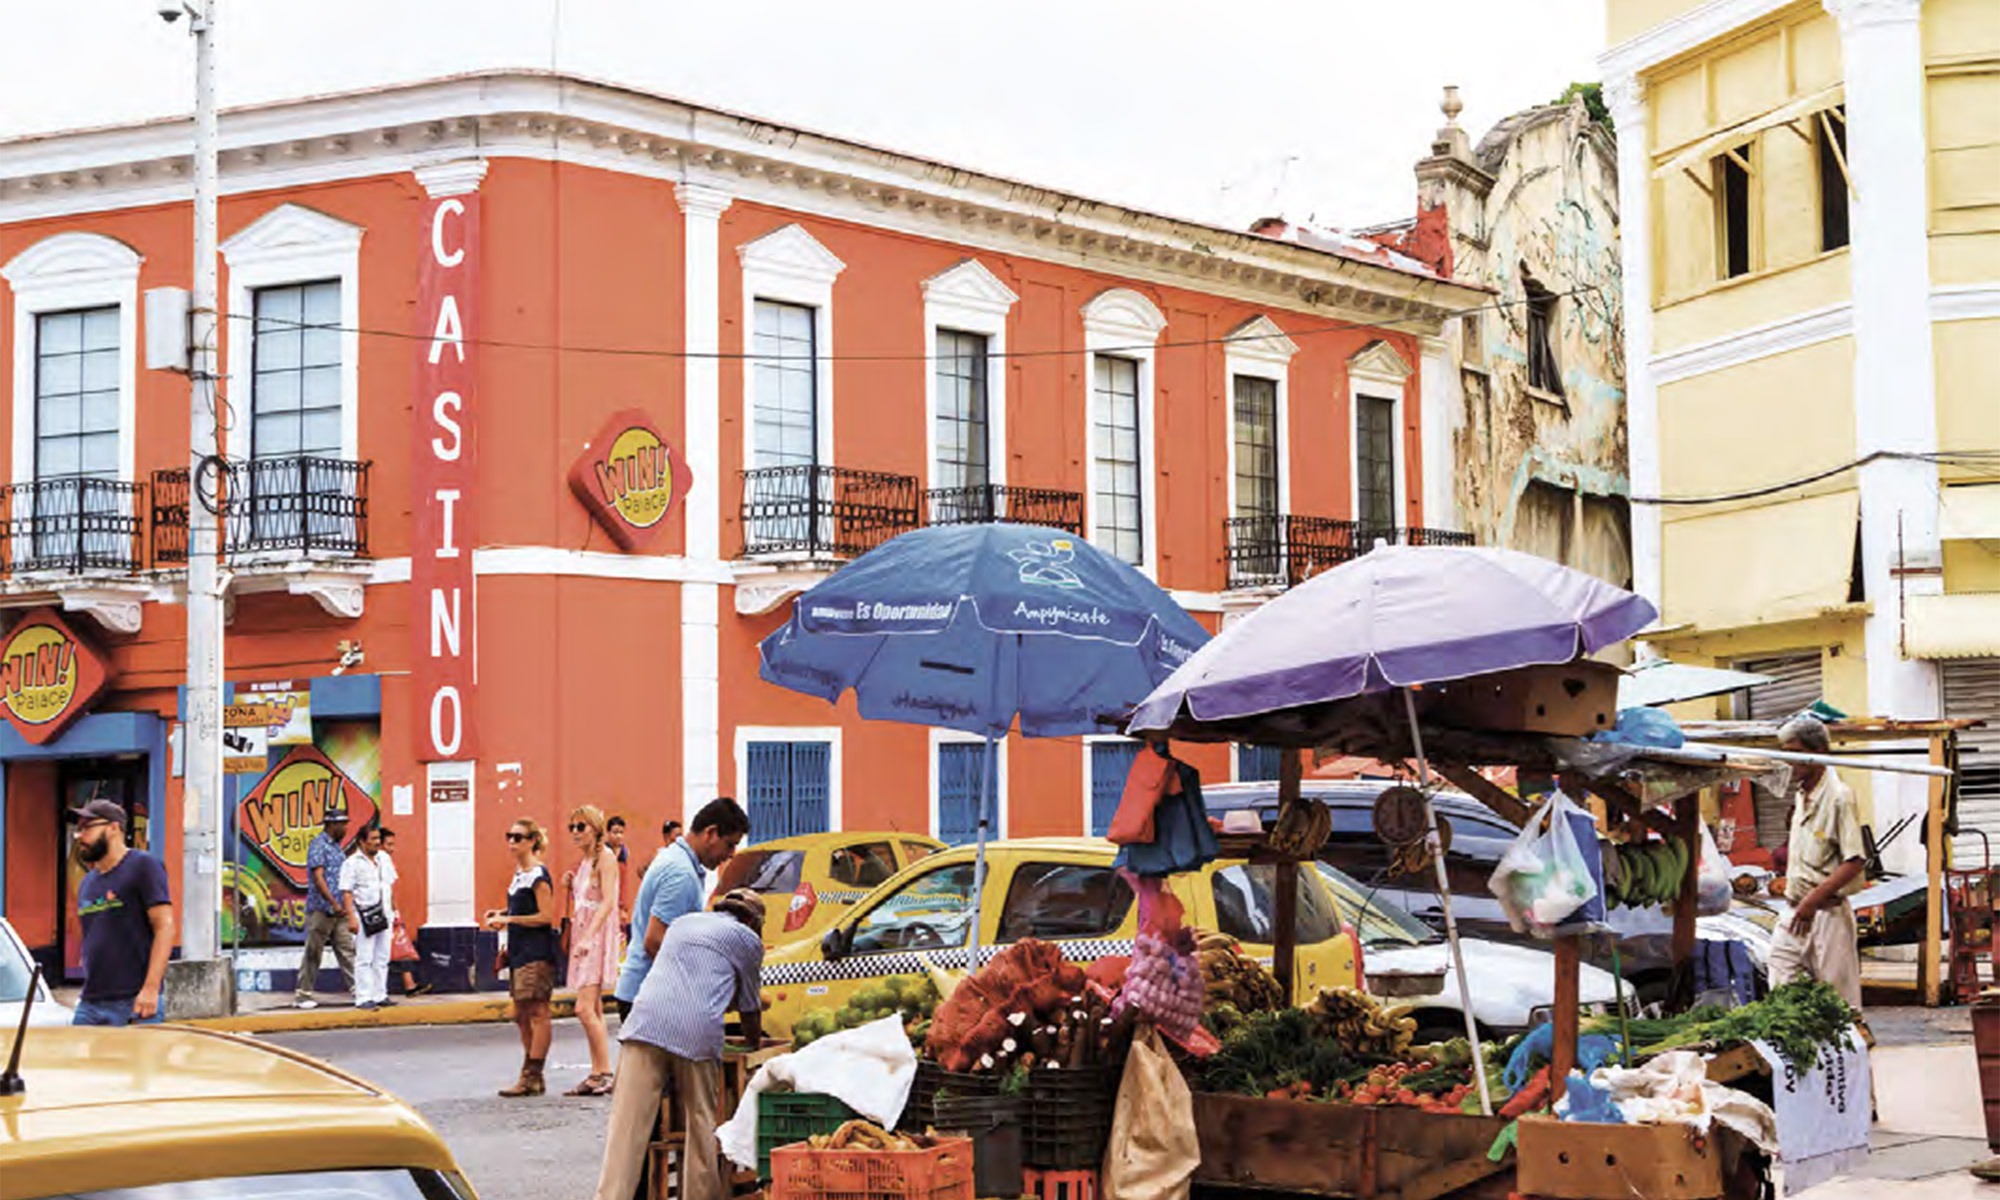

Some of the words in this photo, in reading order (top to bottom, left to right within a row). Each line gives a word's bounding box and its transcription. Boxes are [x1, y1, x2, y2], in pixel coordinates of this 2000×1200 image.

[427, 198, 465, 756] CASINO
[594, 443, 669, 506] WIN!
[872, 602, 953, 622] Oportunidad
[15, 690, 69, 713] Palace
[245, 774, 343, 846] WIN!
